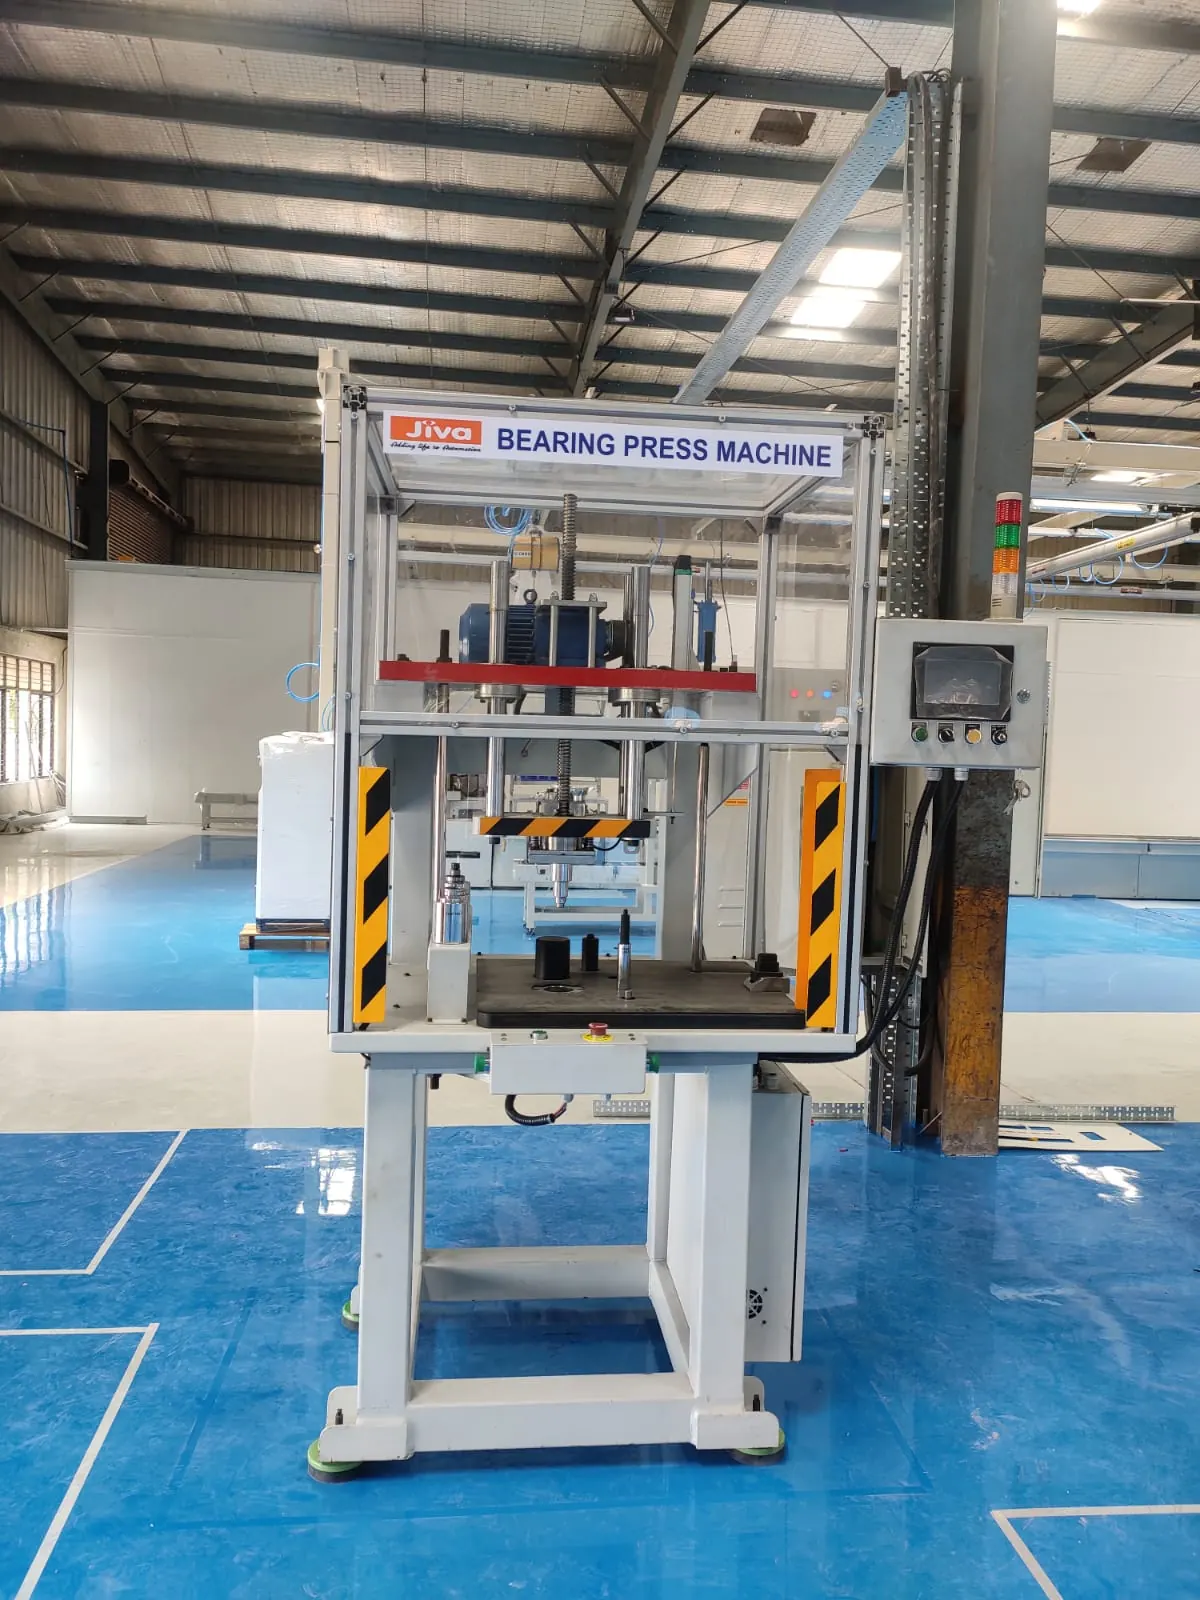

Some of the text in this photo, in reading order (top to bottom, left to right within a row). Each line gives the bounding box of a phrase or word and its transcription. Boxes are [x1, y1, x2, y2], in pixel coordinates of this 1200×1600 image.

[497, 428, 832, 467] BEARING PRESS MACHINE
